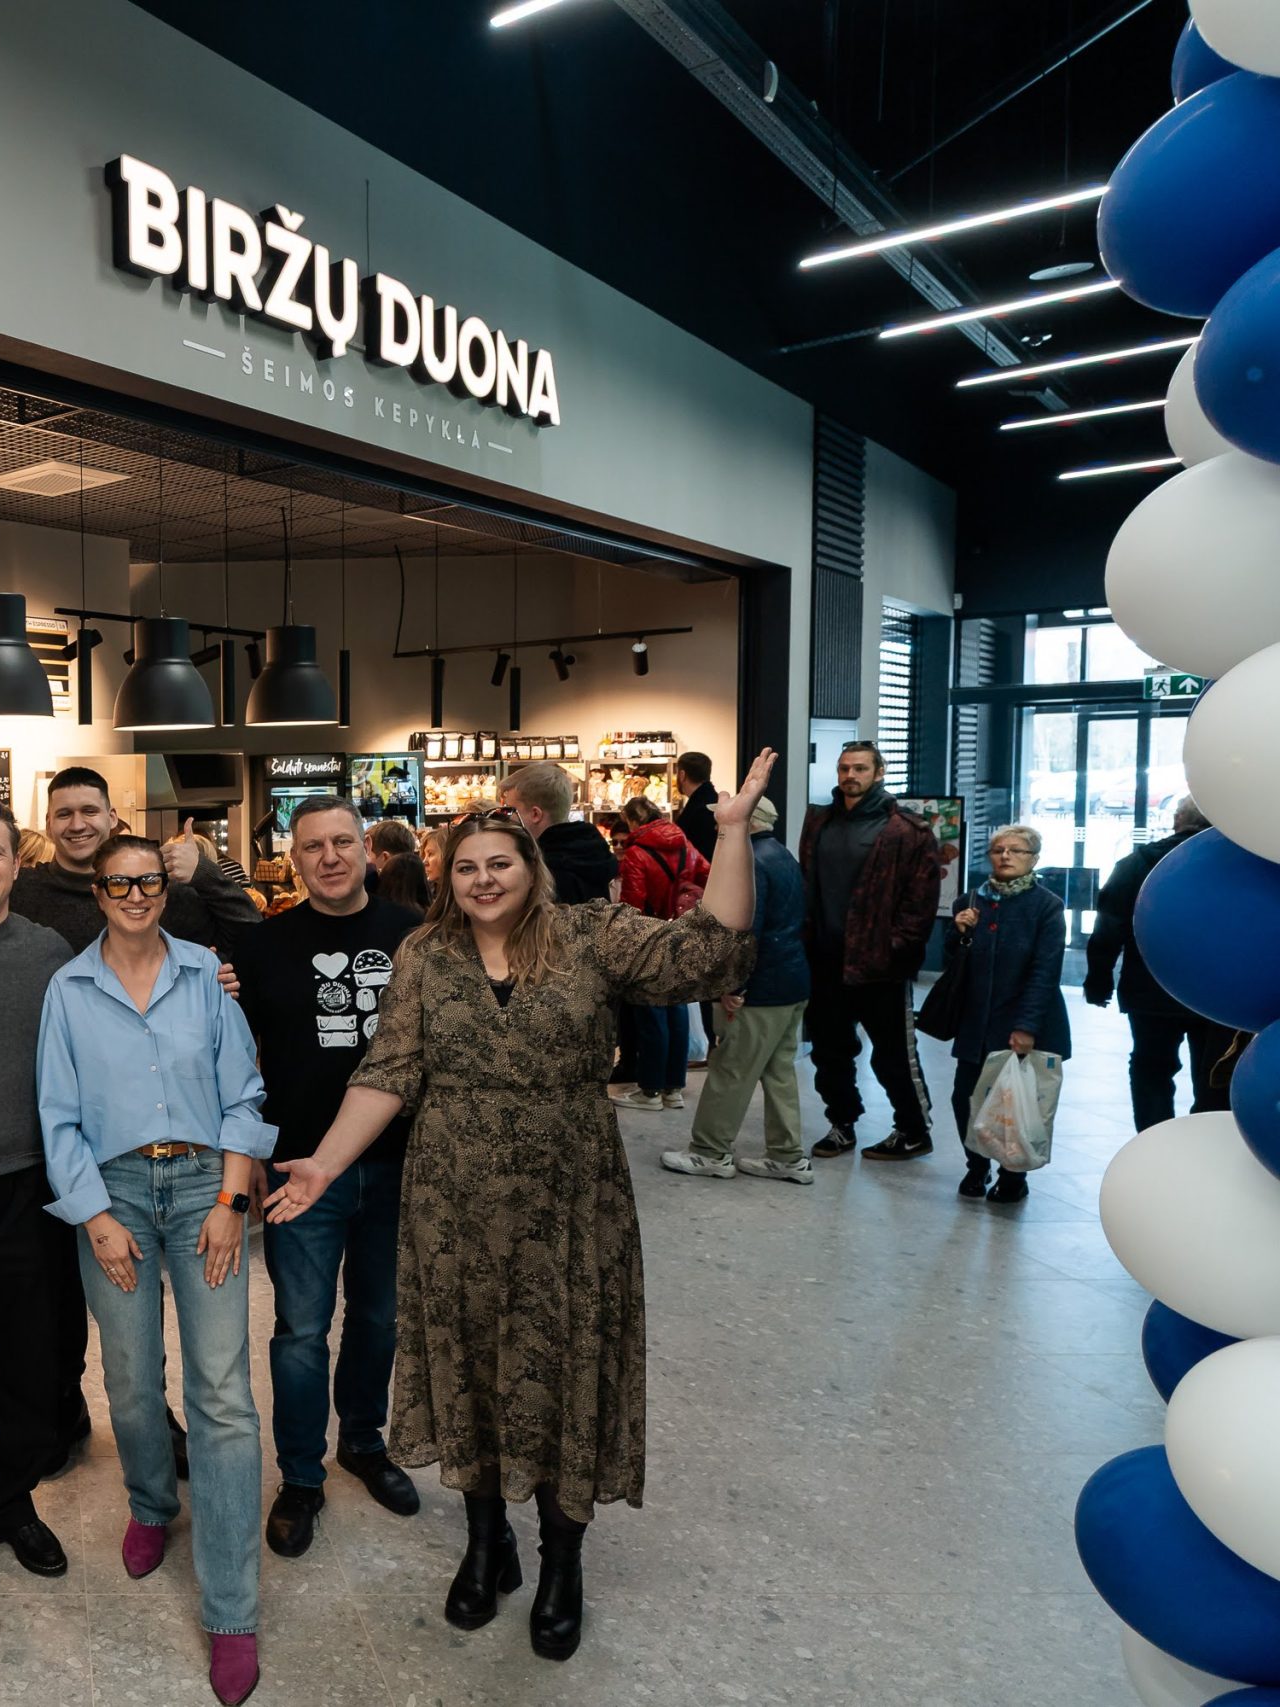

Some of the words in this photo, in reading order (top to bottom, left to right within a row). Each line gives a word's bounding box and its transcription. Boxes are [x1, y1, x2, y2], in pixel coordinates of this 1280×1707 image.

[119, 153, 359, 359] BIRŽŲ
[375, 271, 561, 427] DUONA
[240, 345, 356, 409] ŠEIMOS
[374, 396, 482, 450] KEPYKLA
[332, 980, 352, 998] DUONA
